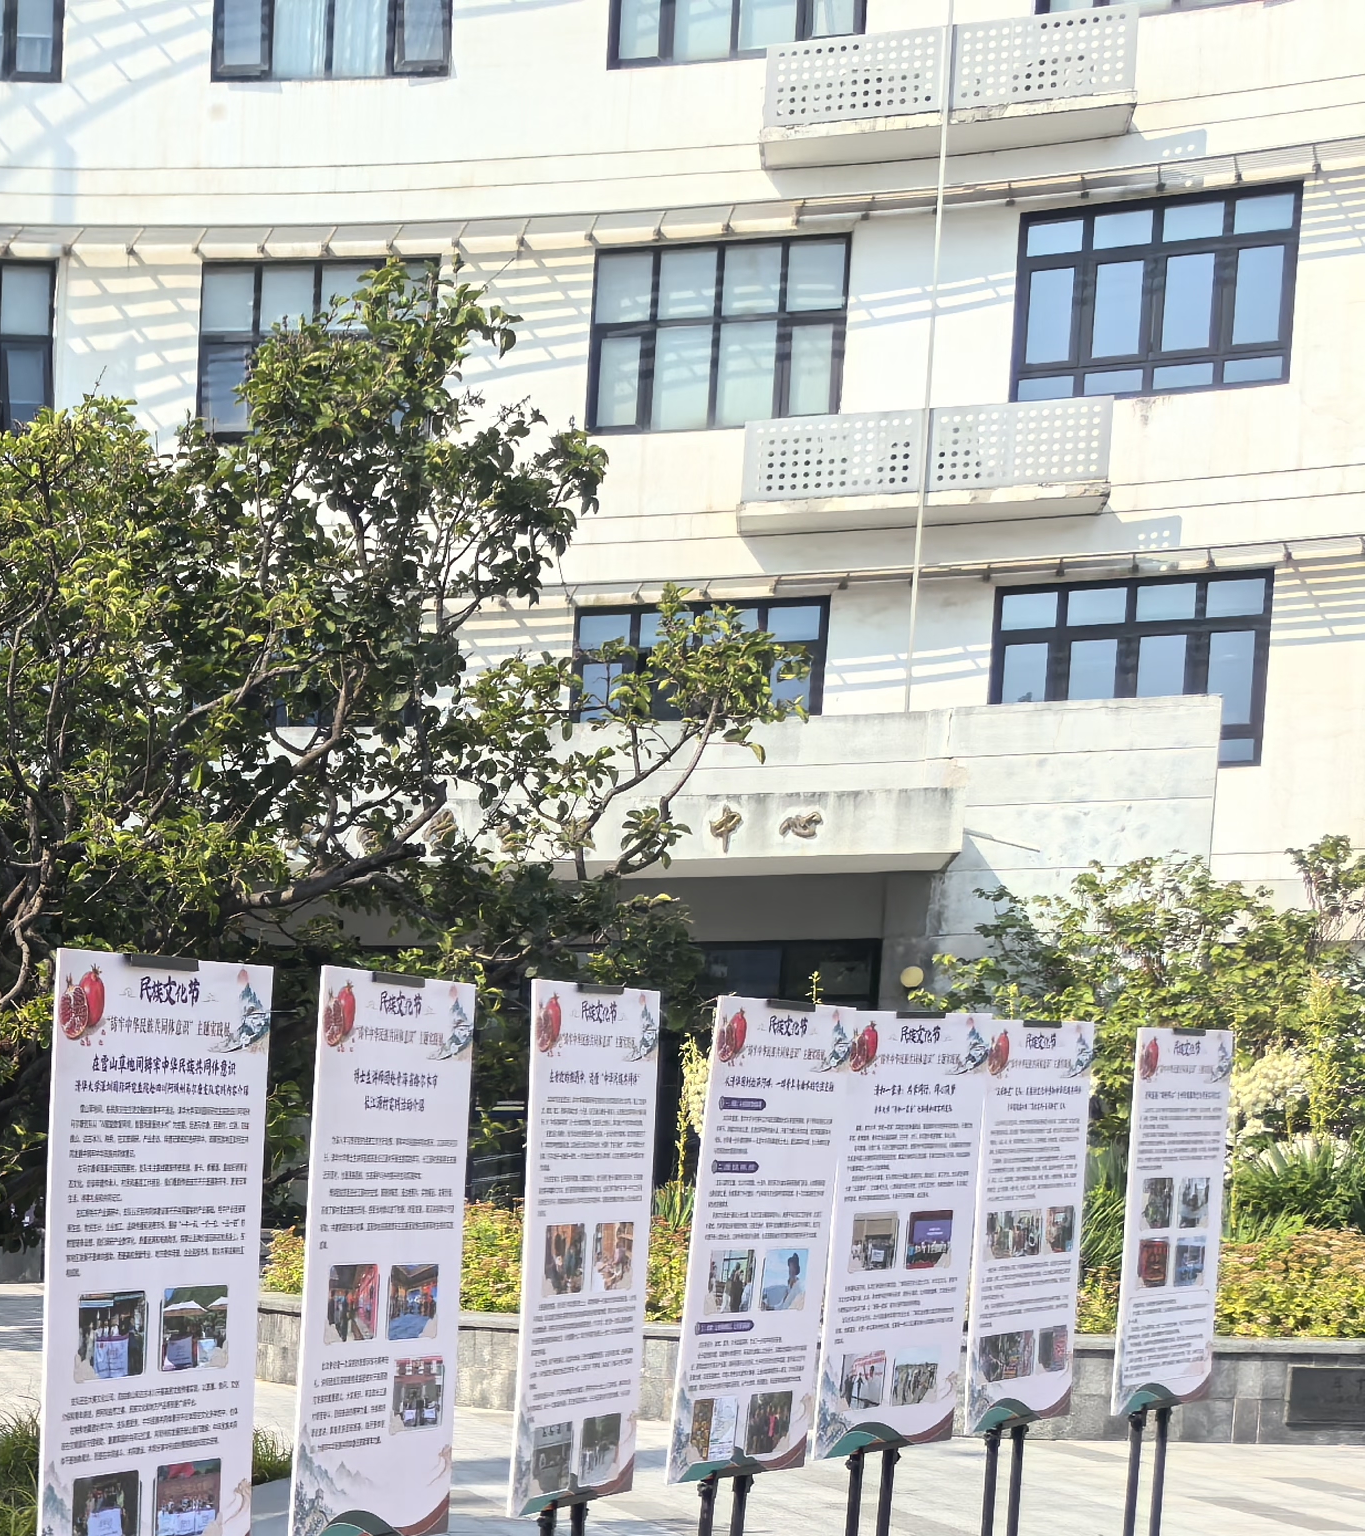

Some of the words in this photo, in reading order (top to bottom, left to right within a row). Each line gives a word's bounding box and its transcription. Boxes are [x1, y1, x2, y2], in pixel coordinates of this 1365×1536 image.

[140, 976, 200, 1007] 民族文化节
